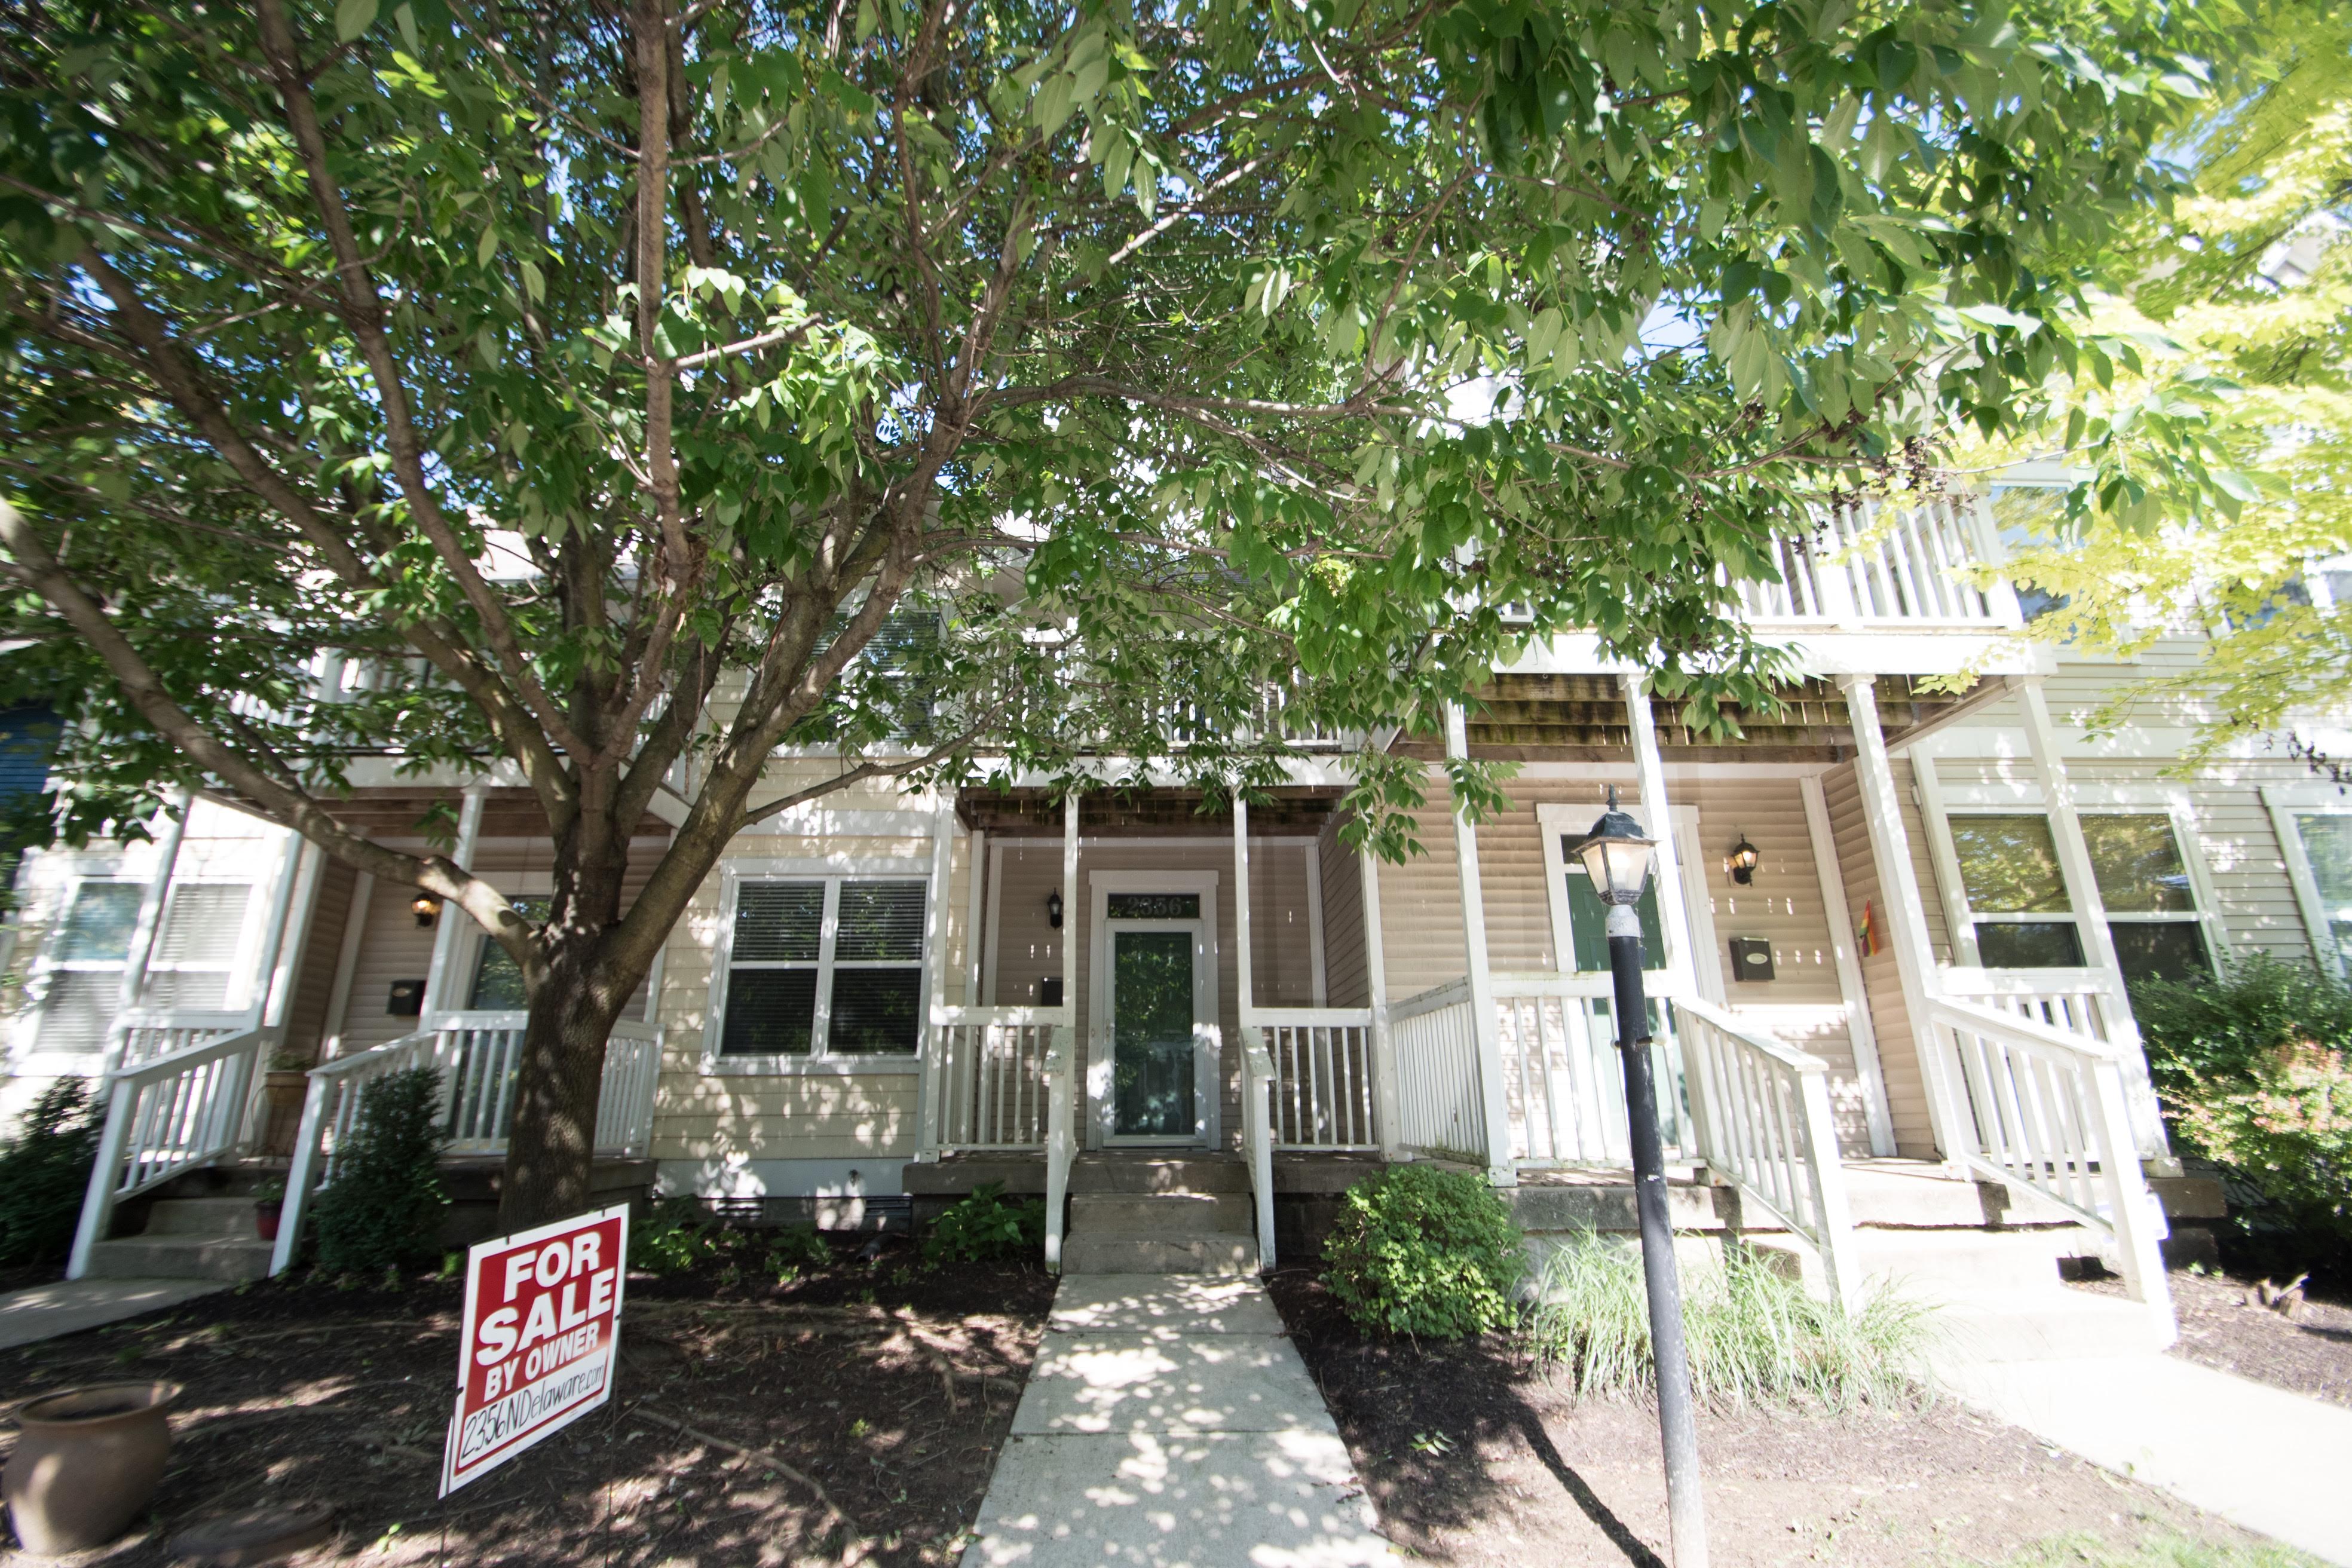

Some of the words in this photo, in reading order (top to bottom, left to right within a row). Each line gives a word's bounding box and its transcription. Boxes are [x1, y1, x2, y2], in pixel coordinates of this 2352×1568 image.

[1127, 897, 1182, 915] 2356
[503, 1232, 601, 1303] FOR
[476, 1267, 615, 1366] SALE
[483, 1356, 520, 1402] BY
[525, 1321, 600, 1380] OWNER
